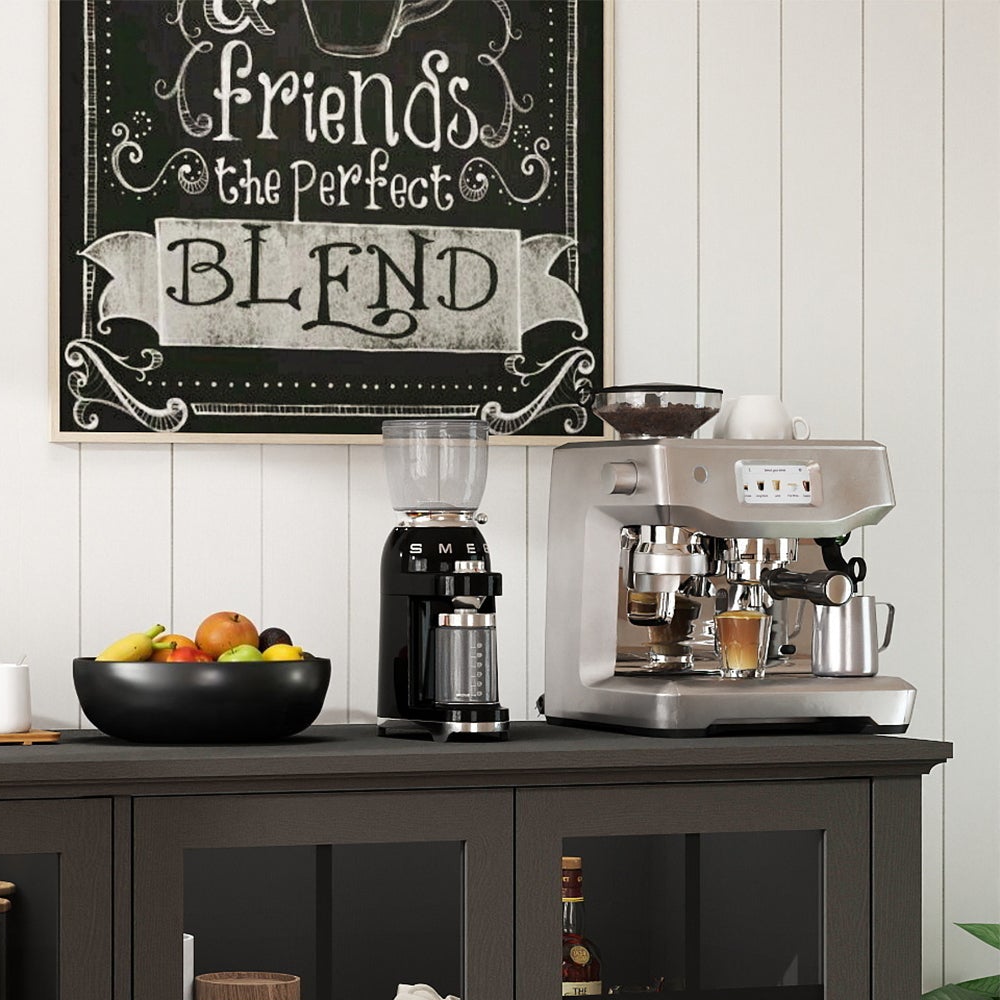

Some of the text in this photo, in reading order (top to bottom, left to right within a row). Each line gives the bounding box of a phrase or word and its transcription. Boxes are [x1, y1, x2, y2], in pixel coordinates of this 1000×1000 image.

[213, 40, 479, 152] friends
[215, 157, 281, 205] the
[166, 223, 498, 339] BLEND
